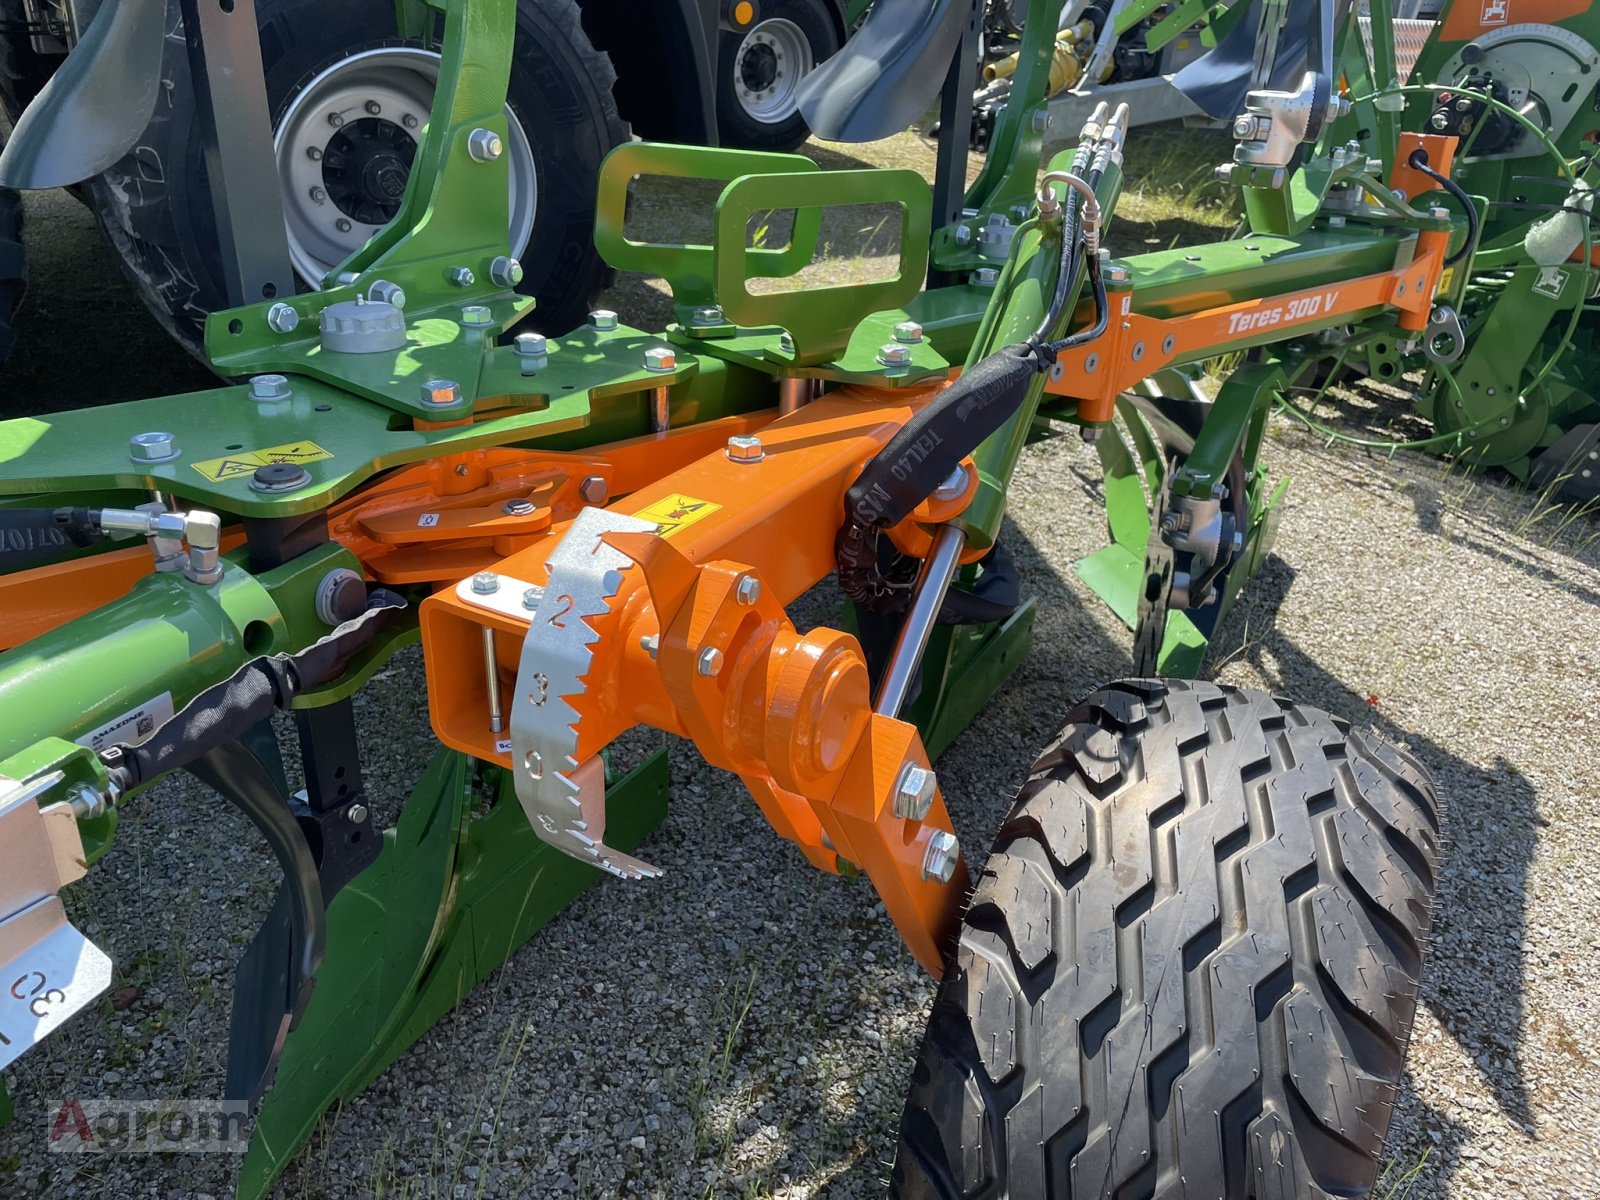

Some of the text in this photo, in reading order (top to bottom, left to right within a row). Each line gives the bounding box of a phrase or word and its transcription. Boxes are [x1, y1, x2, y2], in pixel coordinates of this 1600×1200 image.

[1229, 291, 1339, 335] Teres 300 V
[891, 428, 944, 481] TEXL40
[547, 594, 574, 628] 2
[528, 672, 548, 707] 3
[91, 710, 145, 743] AMAZONE
[524, 750, 544, 780] 0
